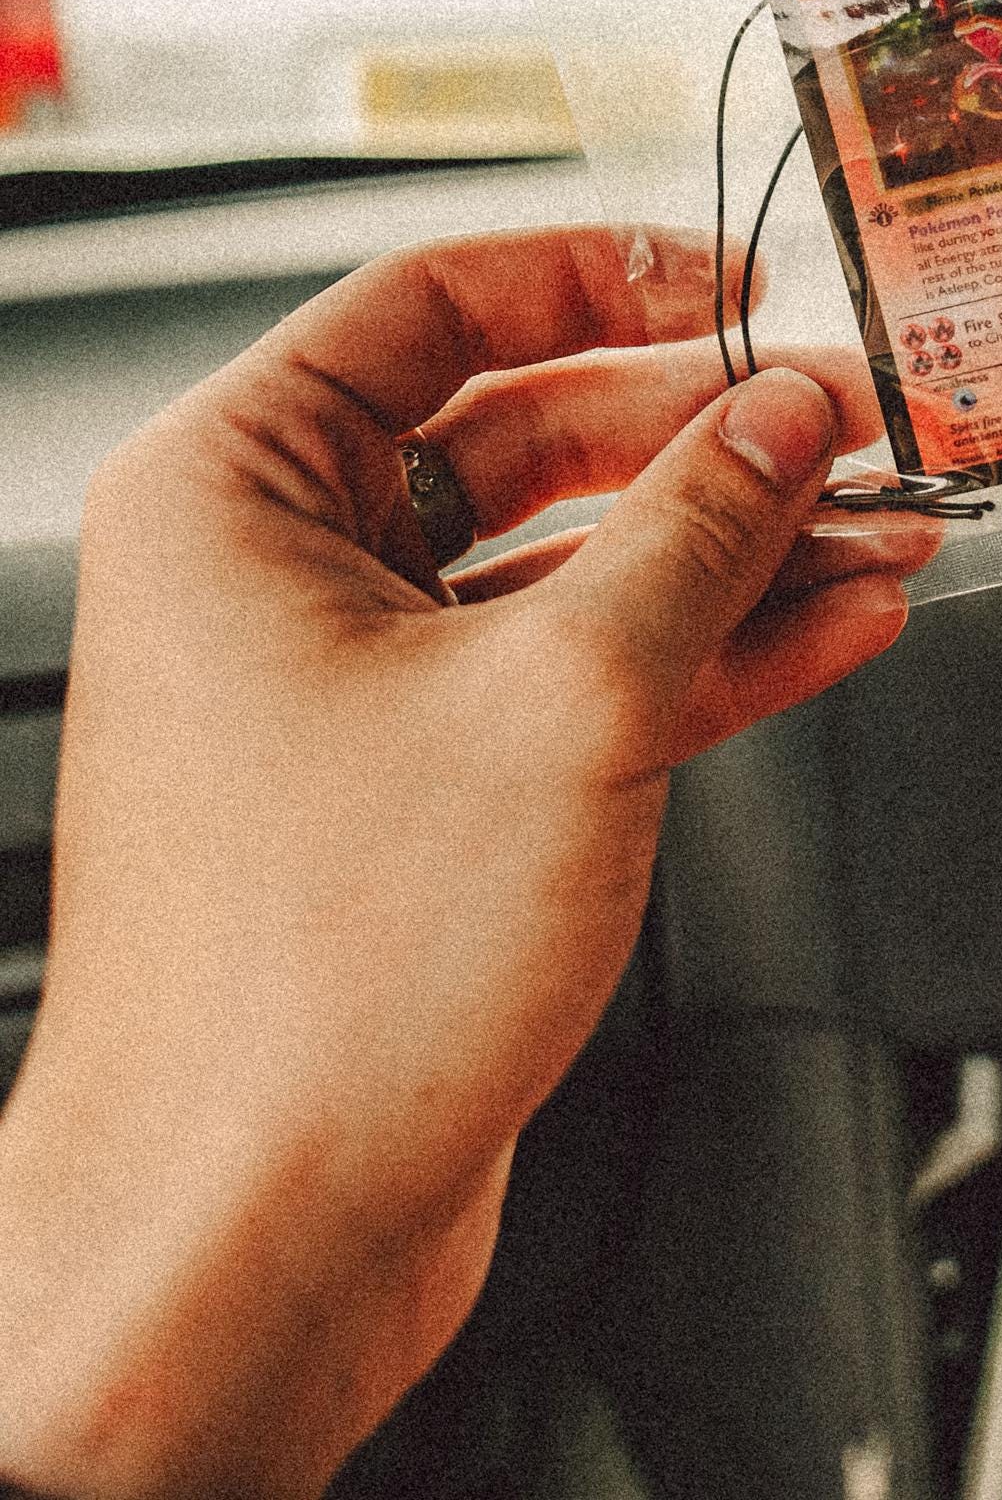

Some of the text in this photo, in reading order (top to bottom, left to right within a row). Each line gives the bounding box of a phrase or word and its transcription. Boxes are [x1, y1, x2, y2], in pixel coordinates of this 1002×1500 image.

[908, 210, 981, 238] Pokémon
[913, 241, 934, 254] like
[937, 231, 978, 250] during
[917, 258, 931, 270] all
[934, 248, 977, 269] Energy
[921, 271, 945, 284] rest
[948, 266, 962, 277] of
[965, 261, 986, 273] the
[924, 289, 934, 299] is
[964, 316, 993, 333] Fire
[968, 338, 982, 348] to
[981, 413, 1002, 428] fire
